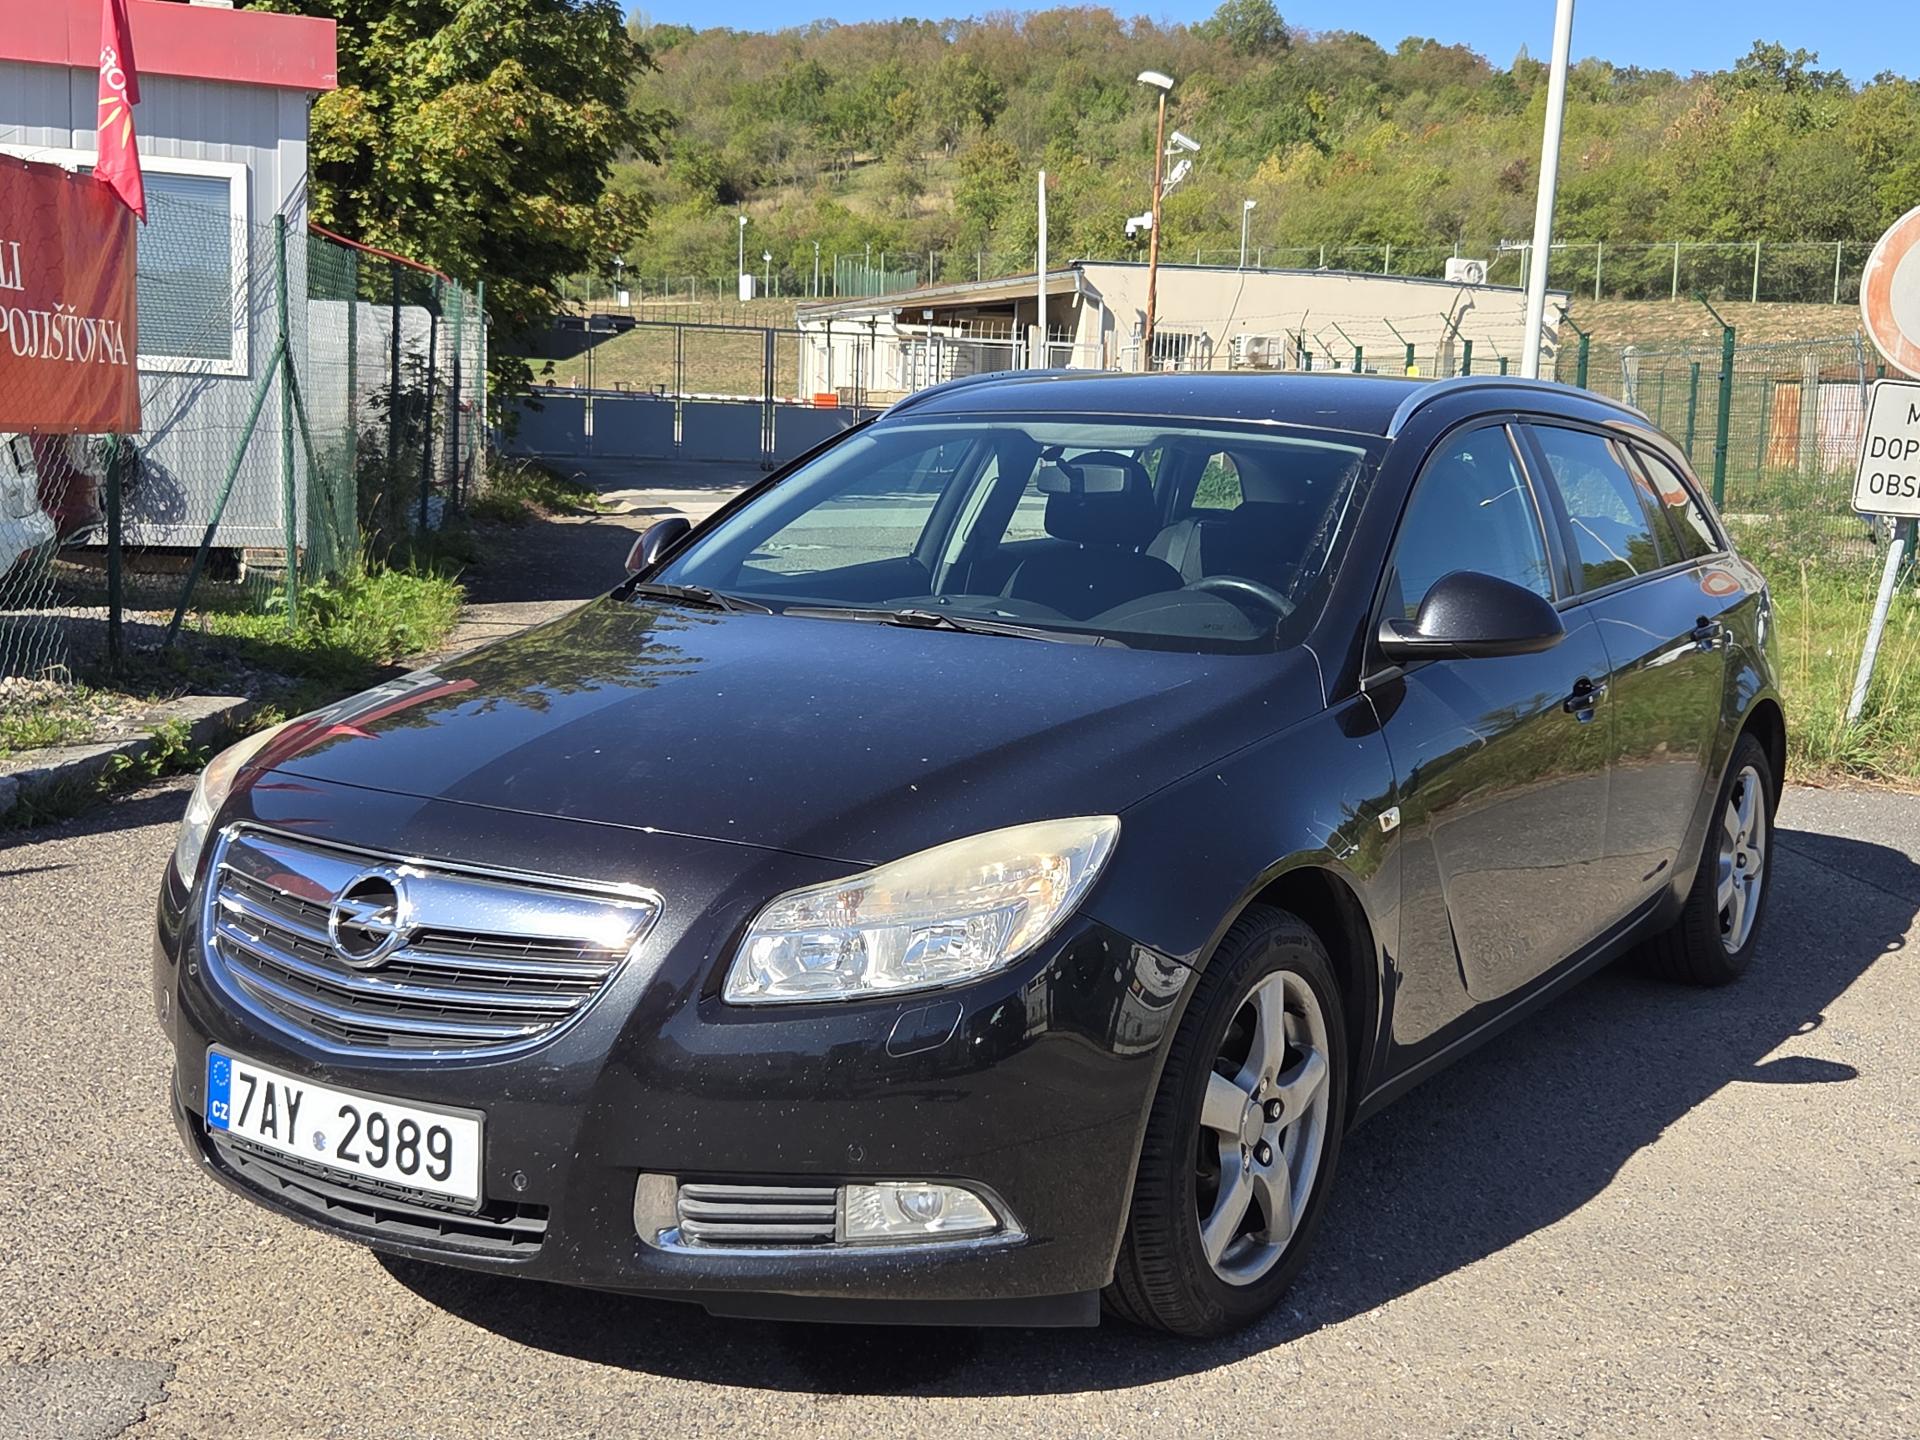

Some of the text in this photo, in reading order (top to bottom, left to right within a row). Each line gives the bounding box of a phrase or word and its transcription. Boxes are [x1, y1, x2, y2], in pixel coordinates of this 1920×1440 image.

[1871, 436, 1920, 461] DOP
[1870, 472, 1920, 499] OBS
[211, 1100, 229, 1120] CZ
[238, 1072, 453, 1182] 7AY 2989
